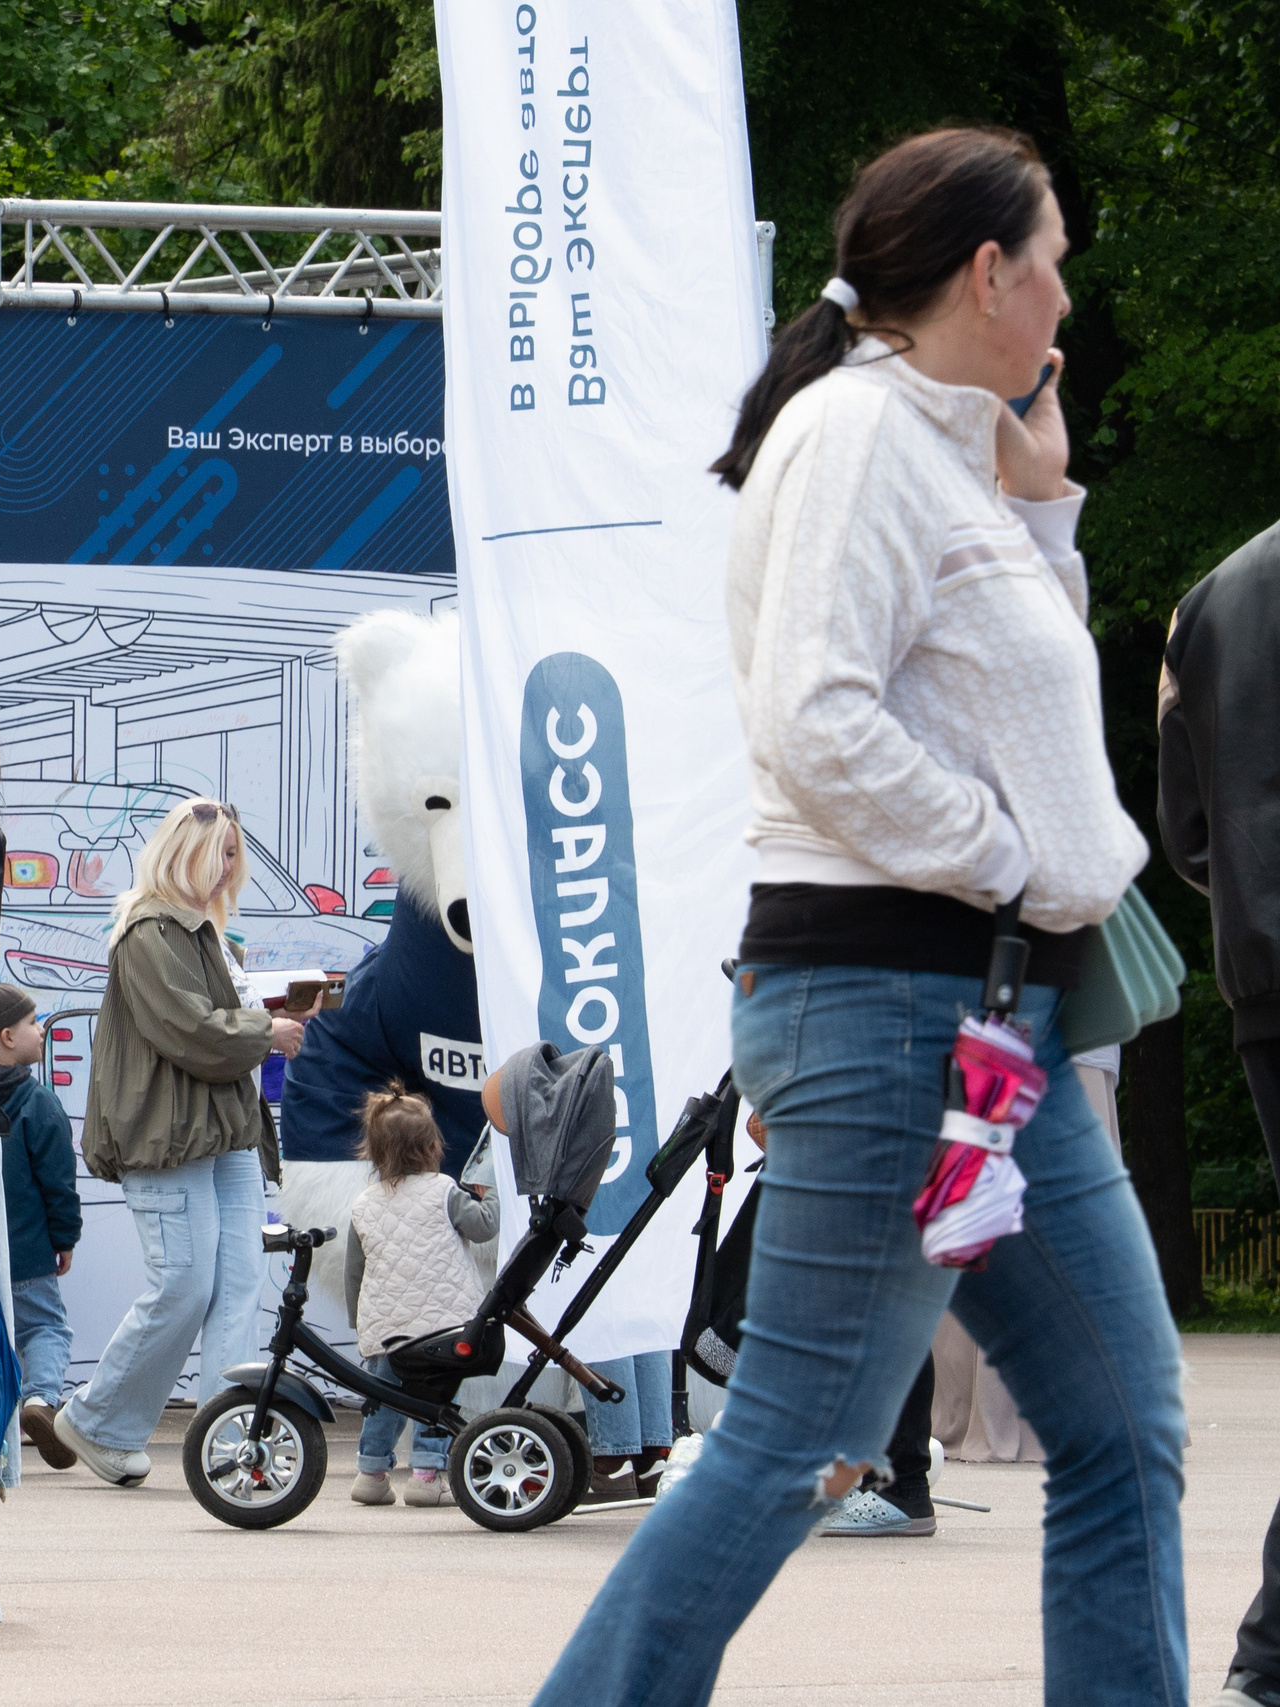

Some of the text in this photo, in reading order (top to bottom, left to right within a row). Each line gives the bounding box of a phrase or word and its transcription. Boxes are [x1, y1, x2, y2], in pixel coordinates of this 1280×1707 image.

[168, 426, 221, 450] Ваш
[227, 427, 333, 457] Эксперт
[339, 435, 353, 453] в
[428, 1047, 489, 1080] АВТ
